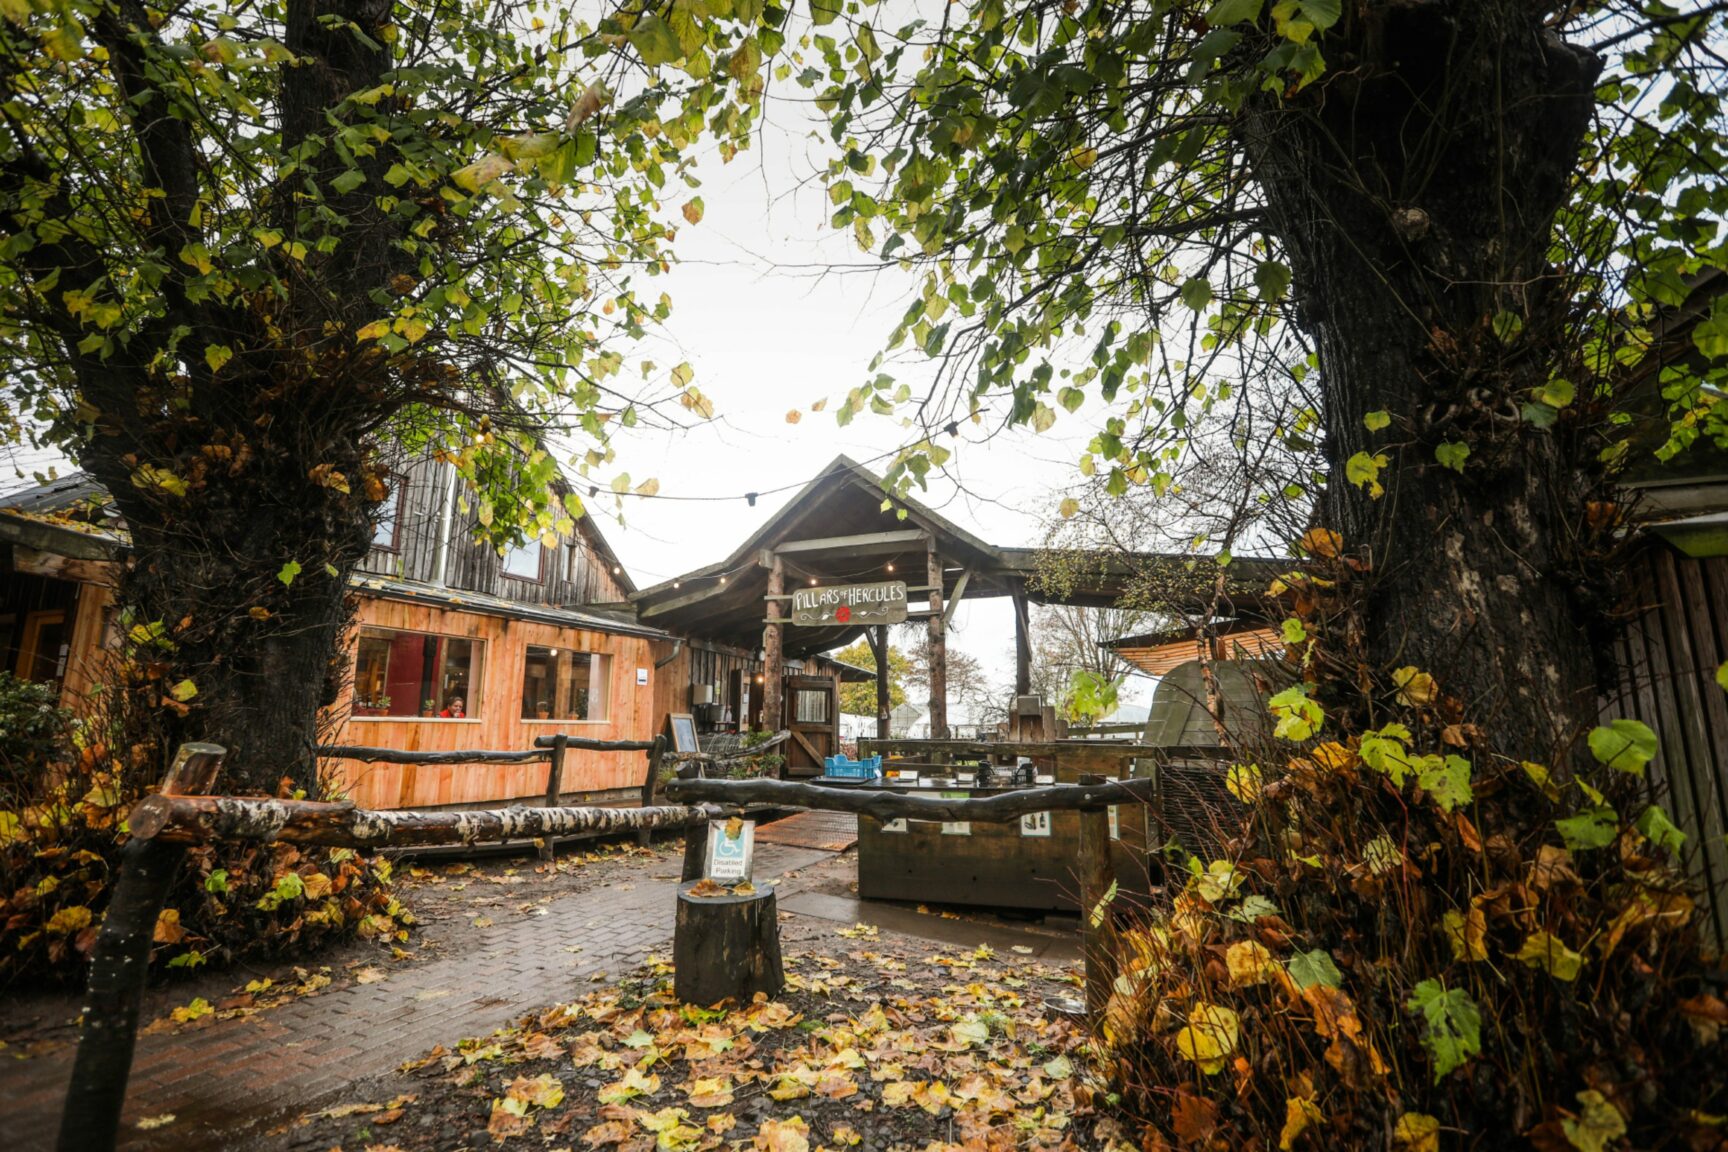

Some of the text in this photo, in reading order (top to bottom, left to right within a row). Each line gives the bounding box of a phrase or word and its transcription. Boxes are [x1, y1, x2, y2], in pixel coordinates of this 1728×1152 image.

[796, 589, 840, 610] PILLARS
[848, 585, 904, 606] HERCULES
[715, 867, 742, 875] Parking
